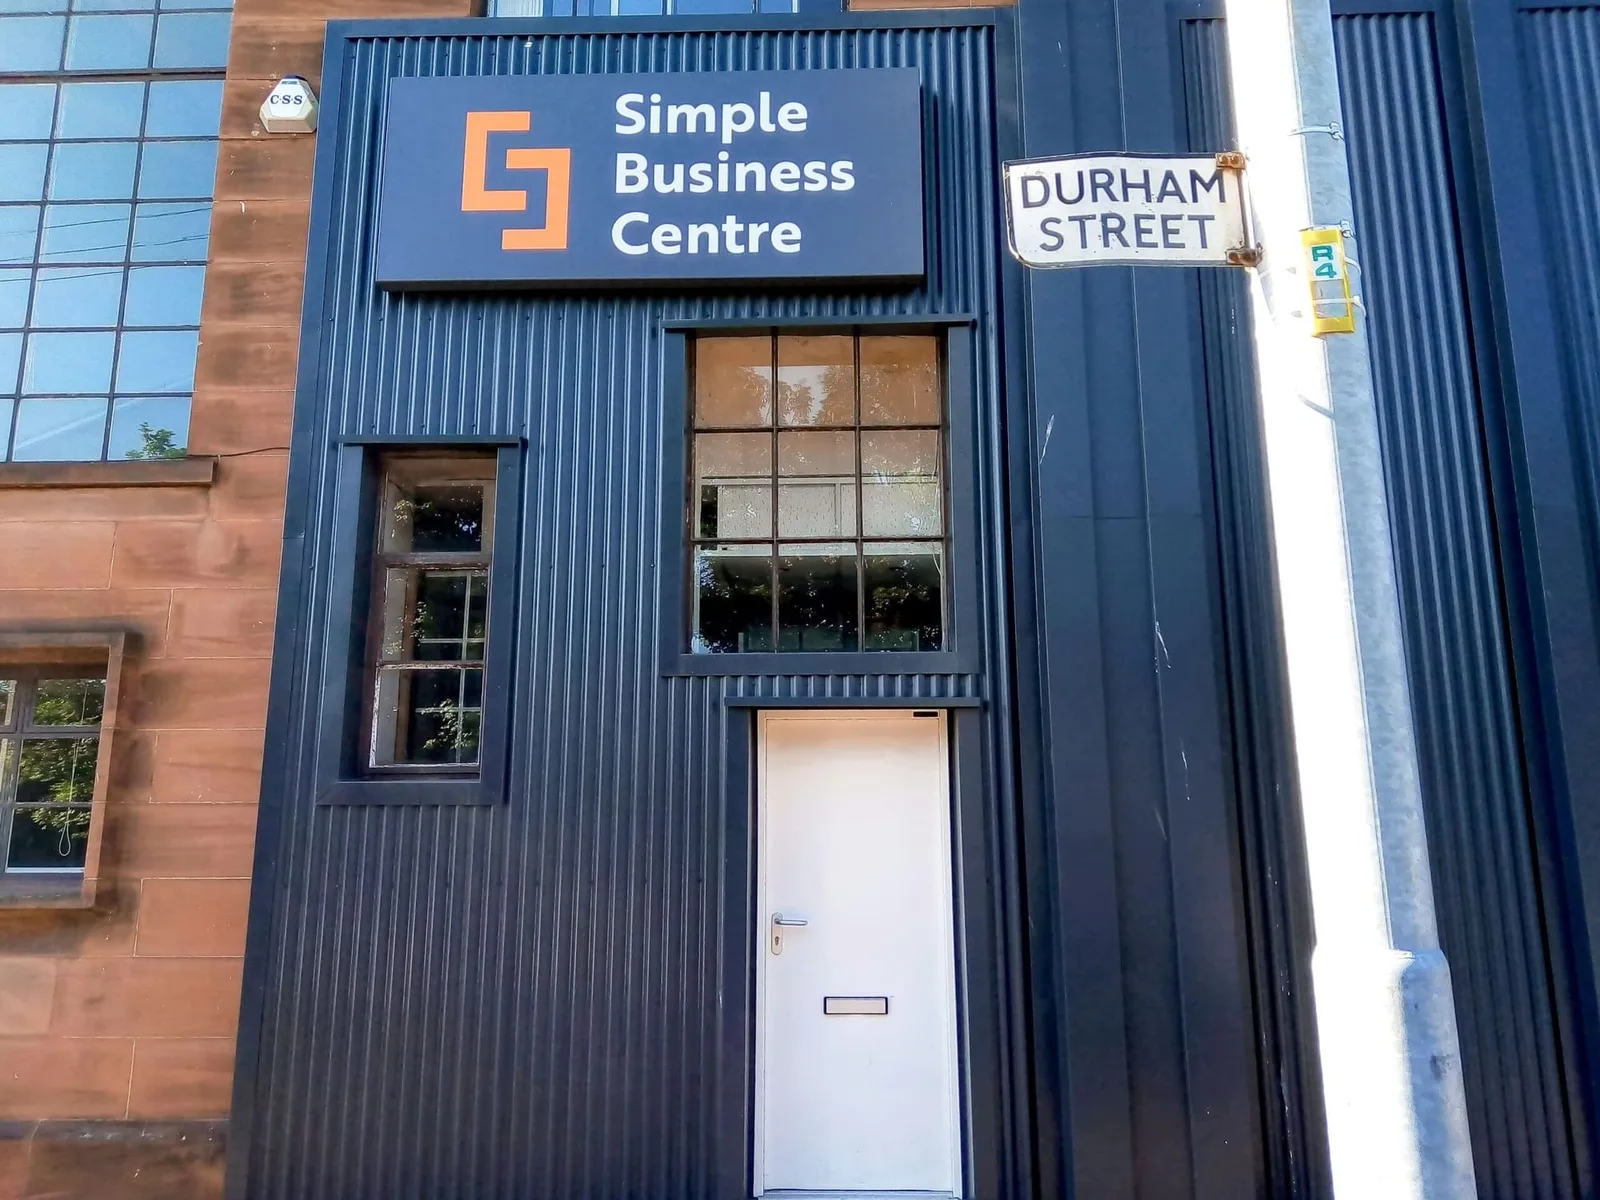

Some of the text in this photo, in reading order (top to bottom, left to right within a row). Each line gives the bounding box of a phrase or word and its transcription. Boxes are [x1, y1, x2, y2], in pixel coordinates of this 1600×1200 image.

[615, 91, 808, 144] Simple
[615, 151, 856, 194] Business
[1021, 168, 1226, 208] DURHAM
[611, 211, 802, 255] Centre
[1039, 213, 1216, 252] STREET
